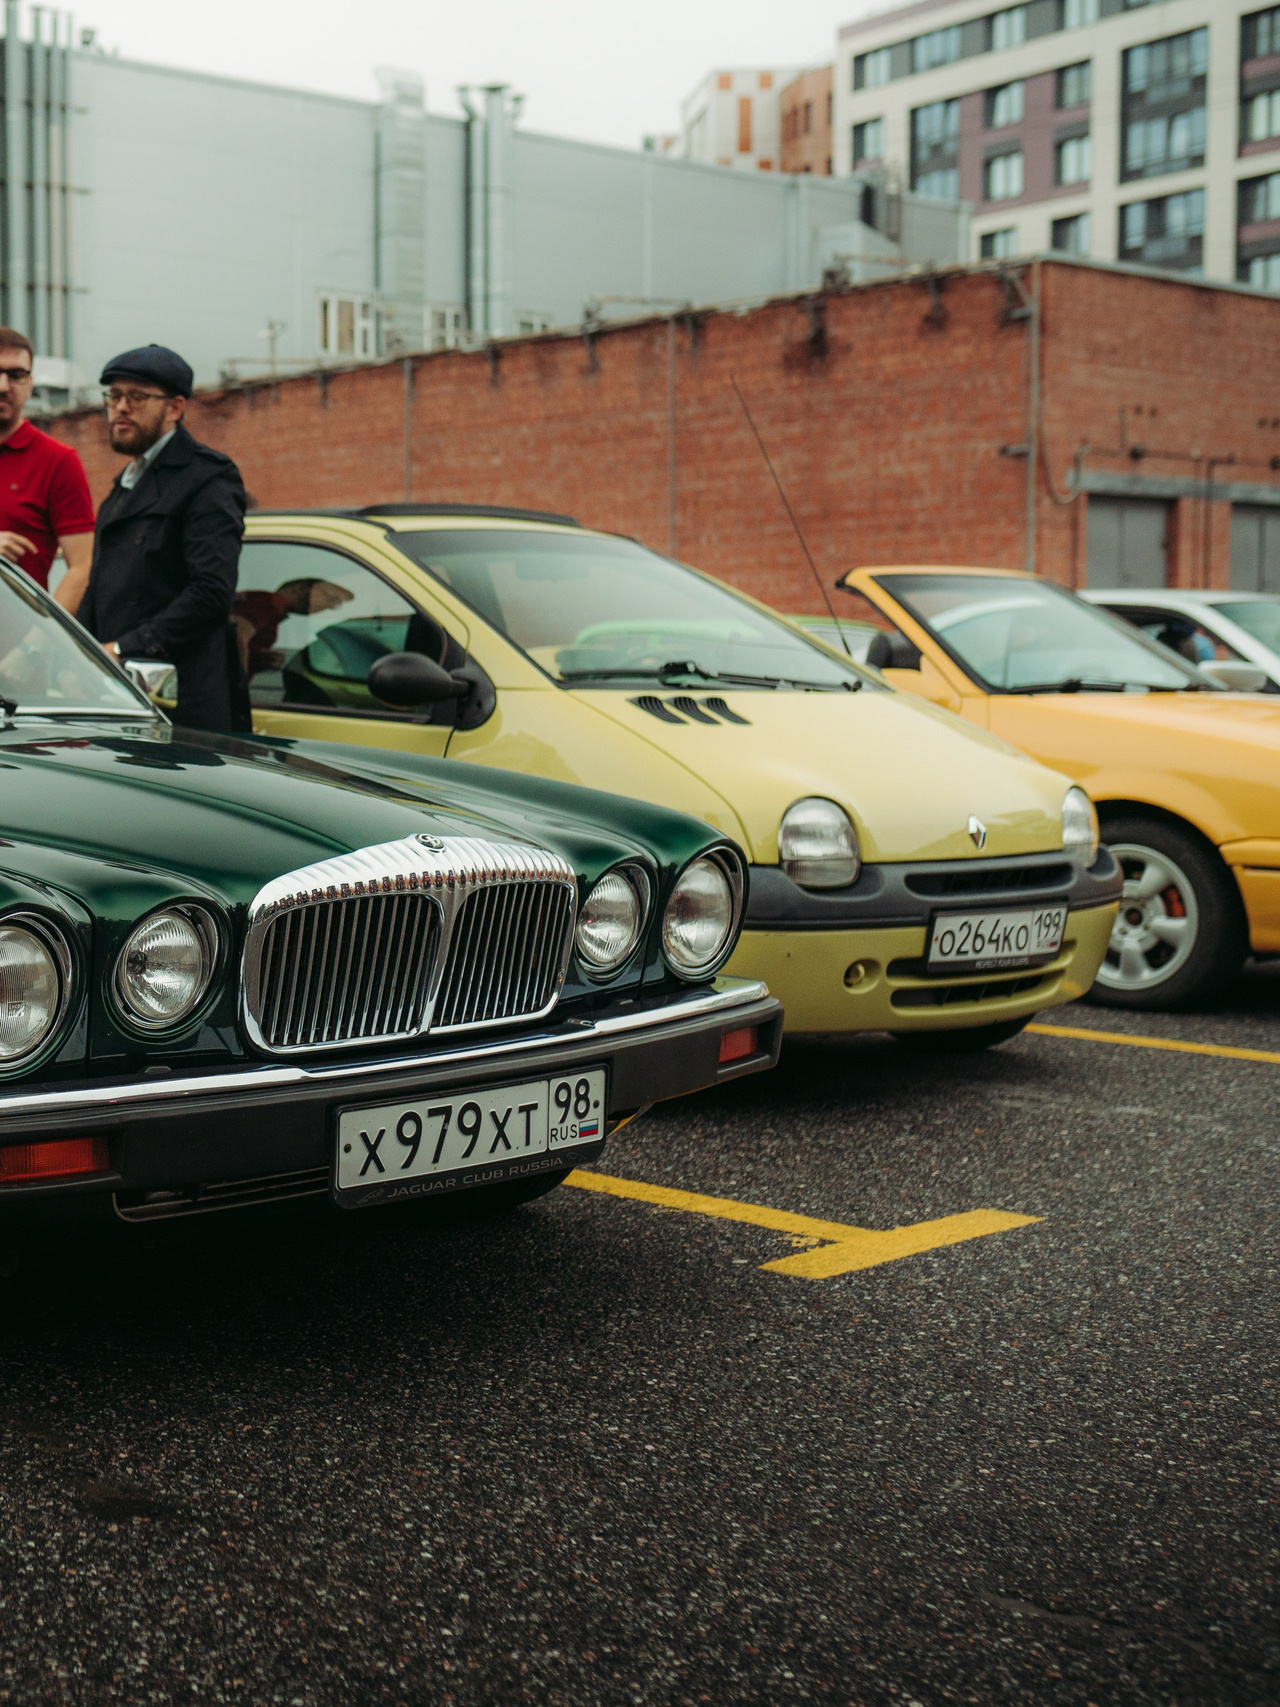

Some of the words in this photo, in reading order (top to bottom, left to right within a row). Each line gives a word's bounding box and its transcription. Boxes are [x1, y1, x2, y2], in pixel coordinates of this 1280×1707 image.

[939, 918, 1029, 957] O264KO
[1034, 911, 1062, 939] 199
[359, 1101, 539, 1176] X979XT
[554, 1077, 591, 1124] 98
[550, 1124, 578, 1143] RUS
[387, 1178, 457, 1198] JAGUAR
[462, 1169, 503, 1185] CLUB
[509, 1157, 563, 1176] RUSSIA
